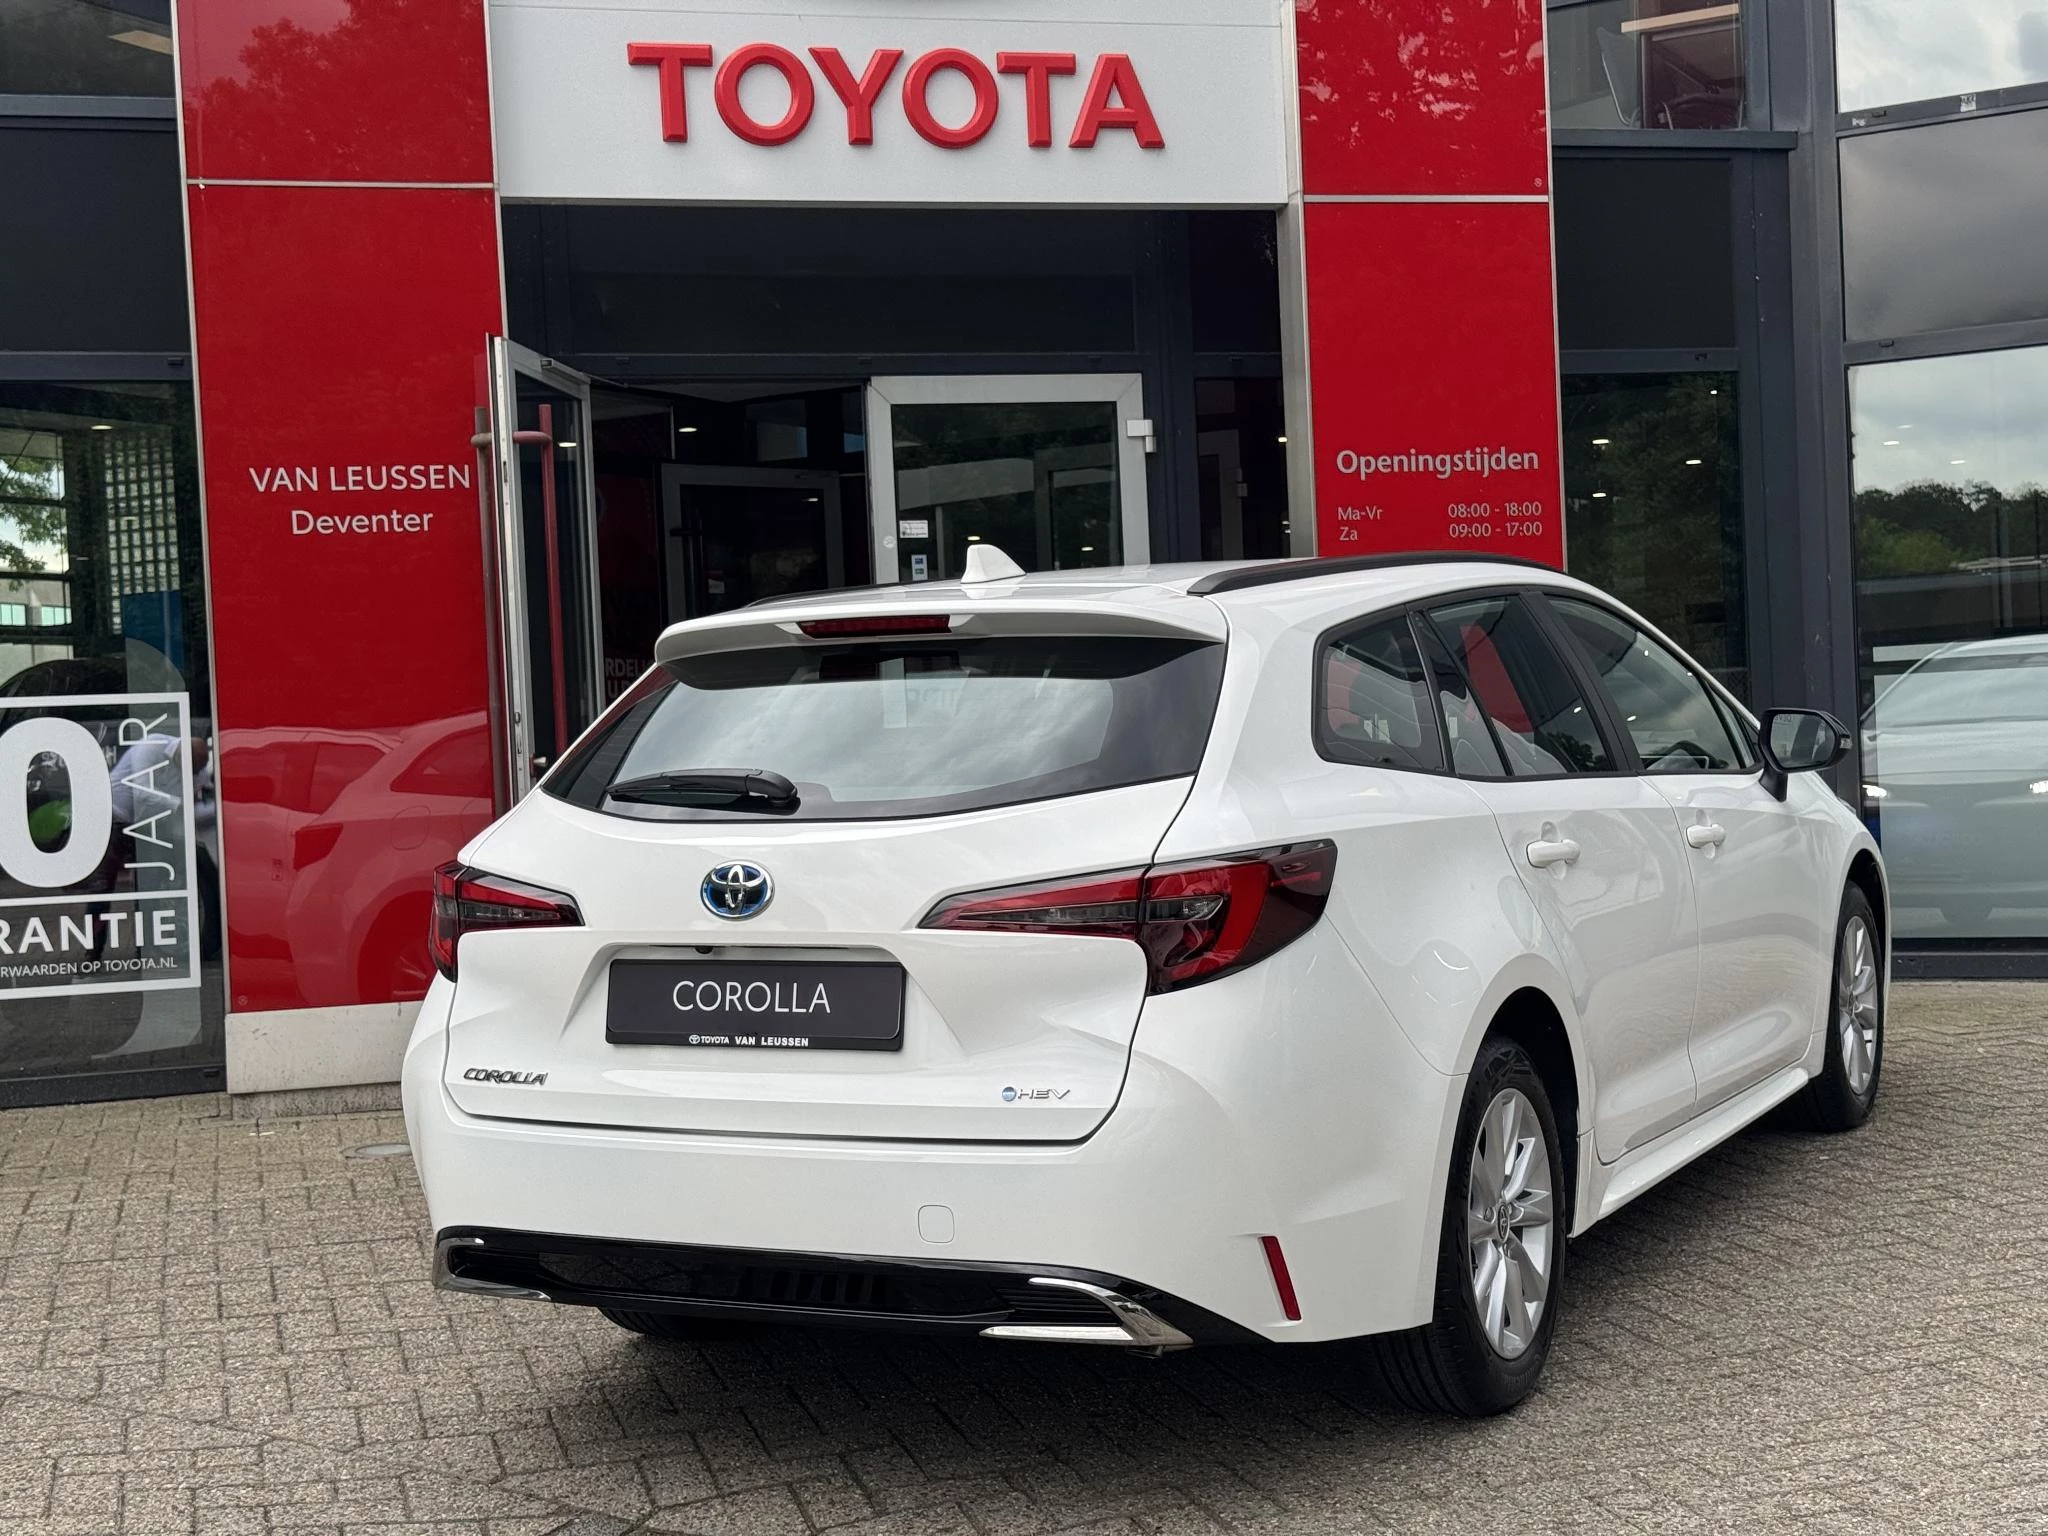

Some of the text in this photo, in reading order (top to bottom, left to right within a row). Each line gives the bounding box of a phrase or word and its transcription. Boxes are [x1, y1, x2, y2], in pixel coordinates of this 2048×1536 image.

[627, 42, 1165, 149] TOYOTA
[1336, 446, 1539, 481] Openingstijden
[249, 464, 471, 492] VAN LEUSSEN
[291, 509, 433, 535] Deventer
[1337, 506, 1382, 520] Ma-Vr
[1448, 503, 1490, 518] 08:00
[1504, 501, 1542, 516] 18:00
[1339, 526, 1358, 540] Za
[1449, 523, 1491, 538] 09:00
[1505, 521, 1543, 536] 17:00
[0, 717, 112, 888] 0
[119, 713, 175, 881] JAAR
[0, 957, 178, 978] RWAARDEN OP TOYOTA.NL
[673, 980, 831, 1013] COROLLA
[700, 1036, 809, 1047] TOYOTA VAN LEUSSEN
[463, 1068, 549, 1086] COROLLA
[1018, 1089, 1070, 1100] HEV
